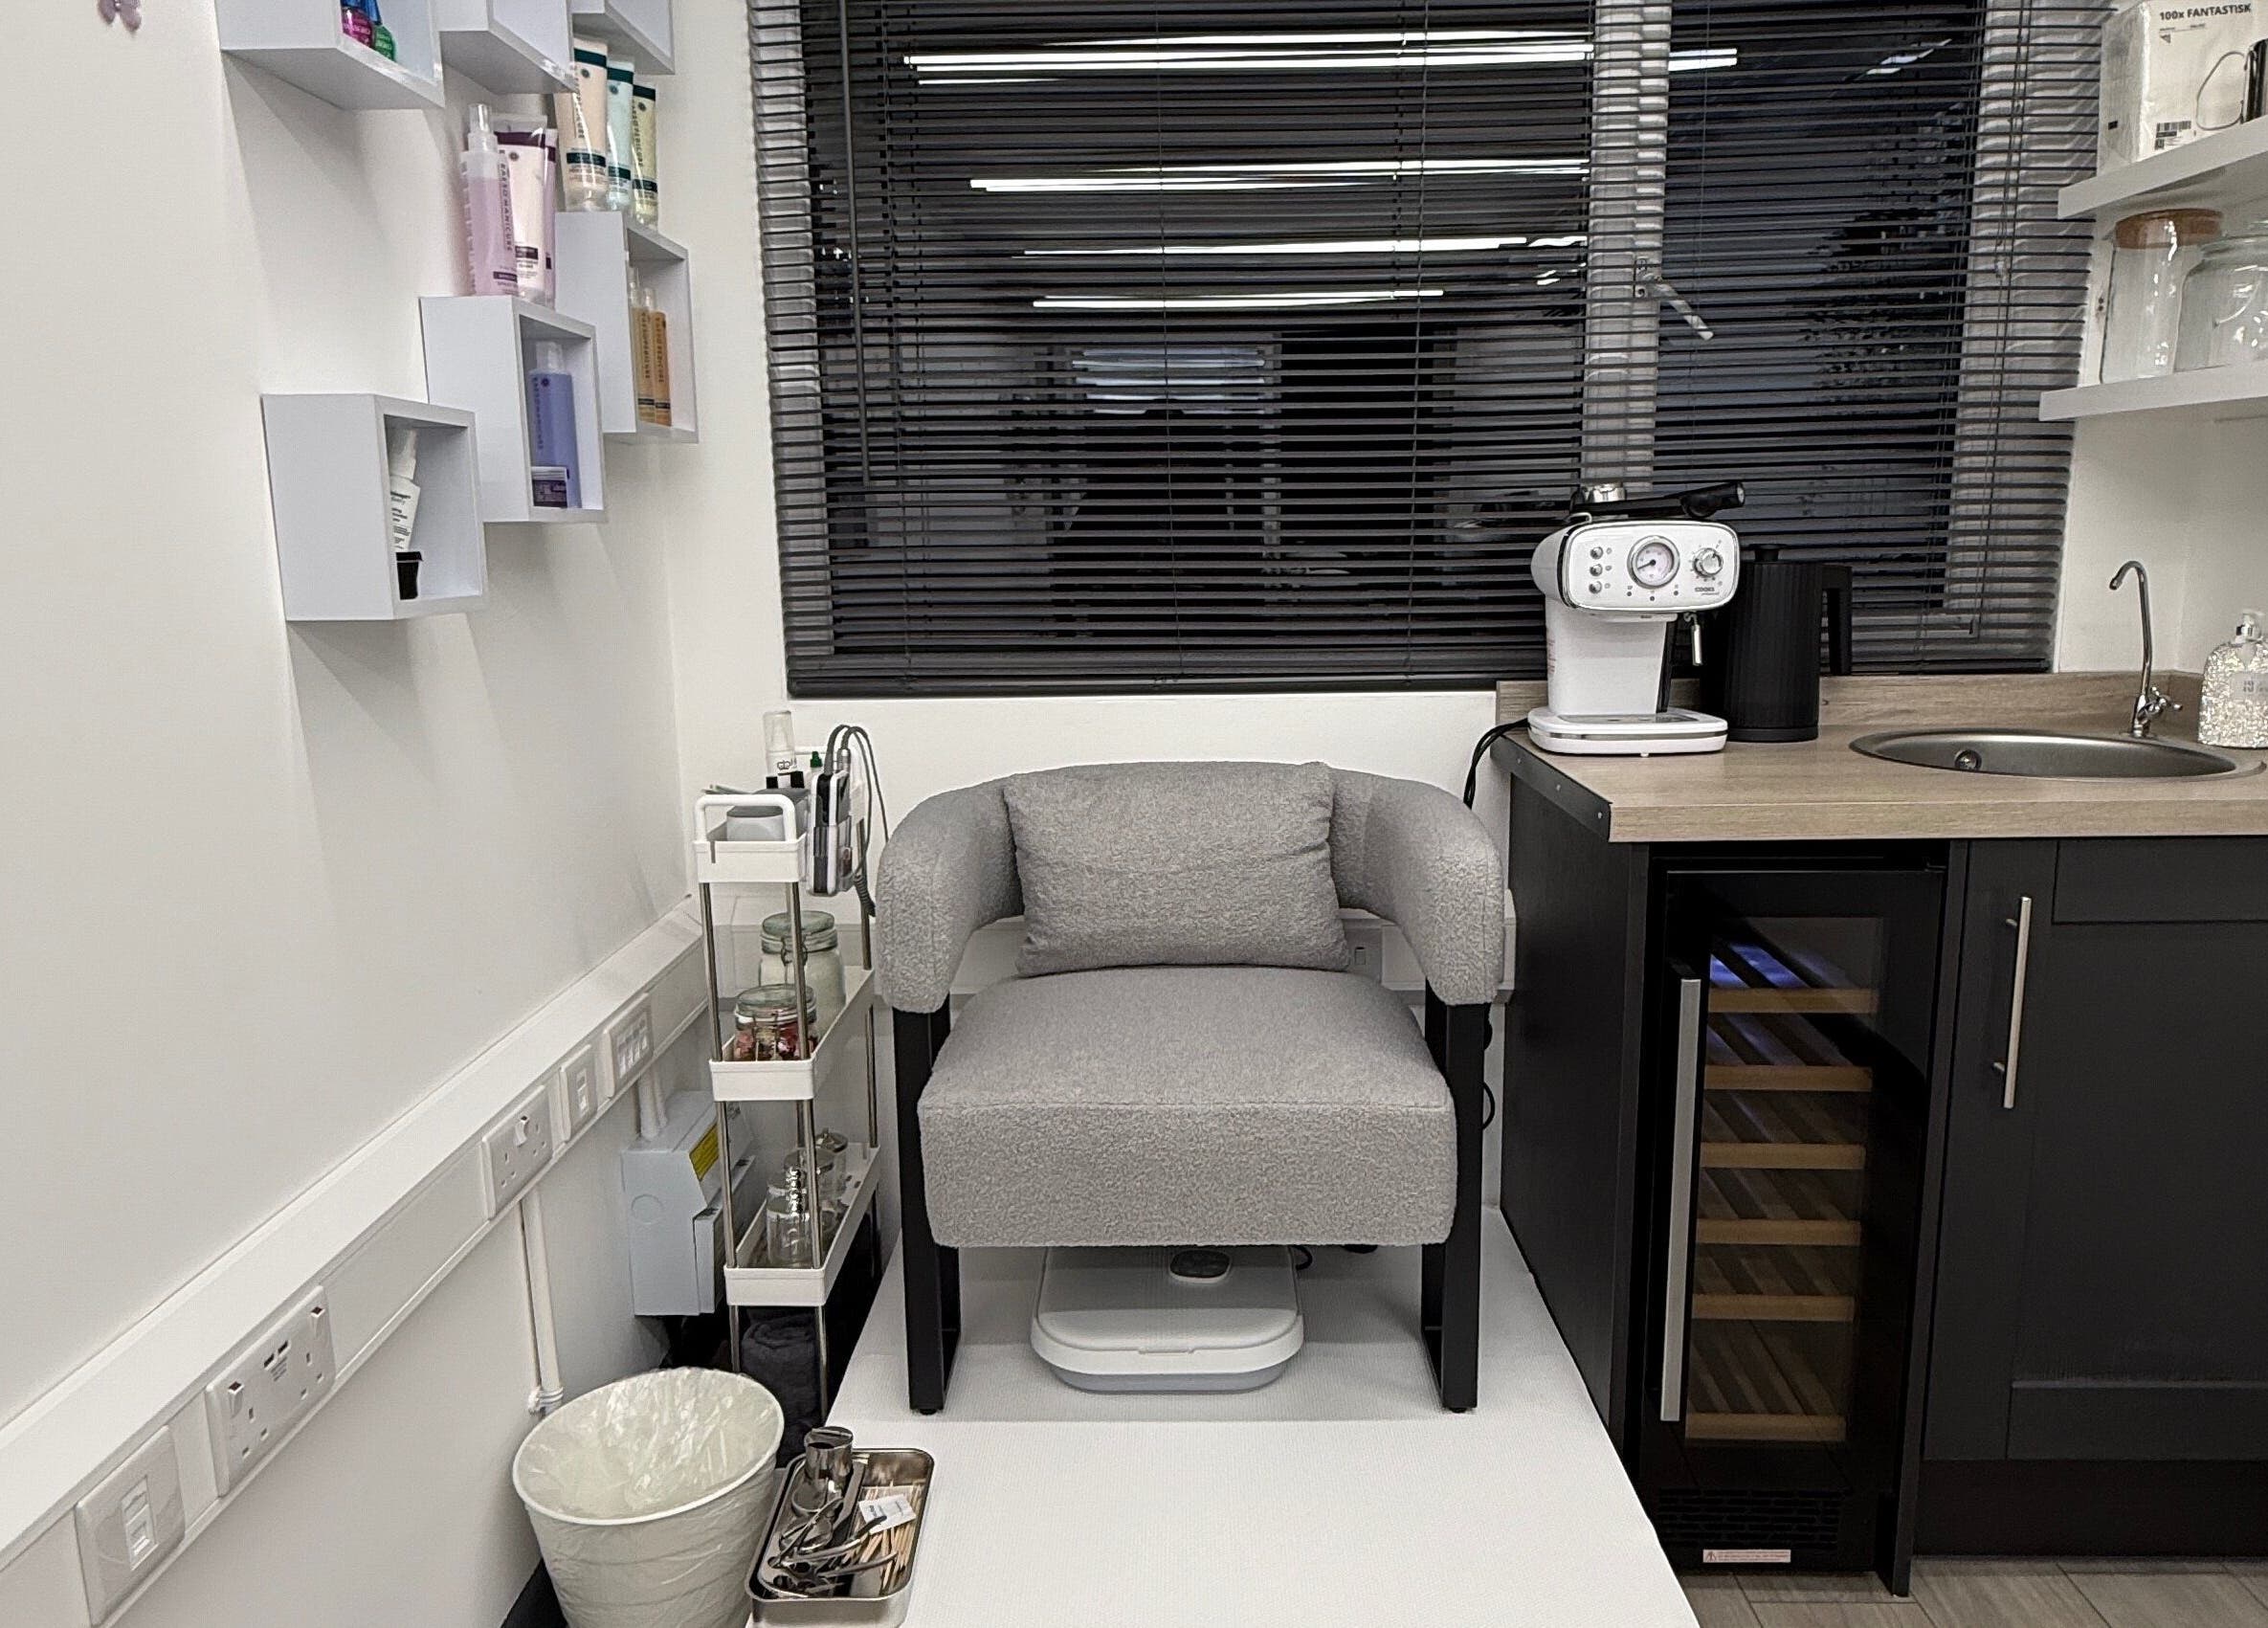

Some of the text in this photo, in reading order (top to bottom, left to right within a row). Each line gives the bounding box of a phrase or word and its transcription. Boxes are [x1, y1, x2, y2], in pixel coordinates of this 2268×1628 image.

[2160, 3, 2251, 20] 100x FANTASTISK
[502, 198, 514, 252] MANICURE
